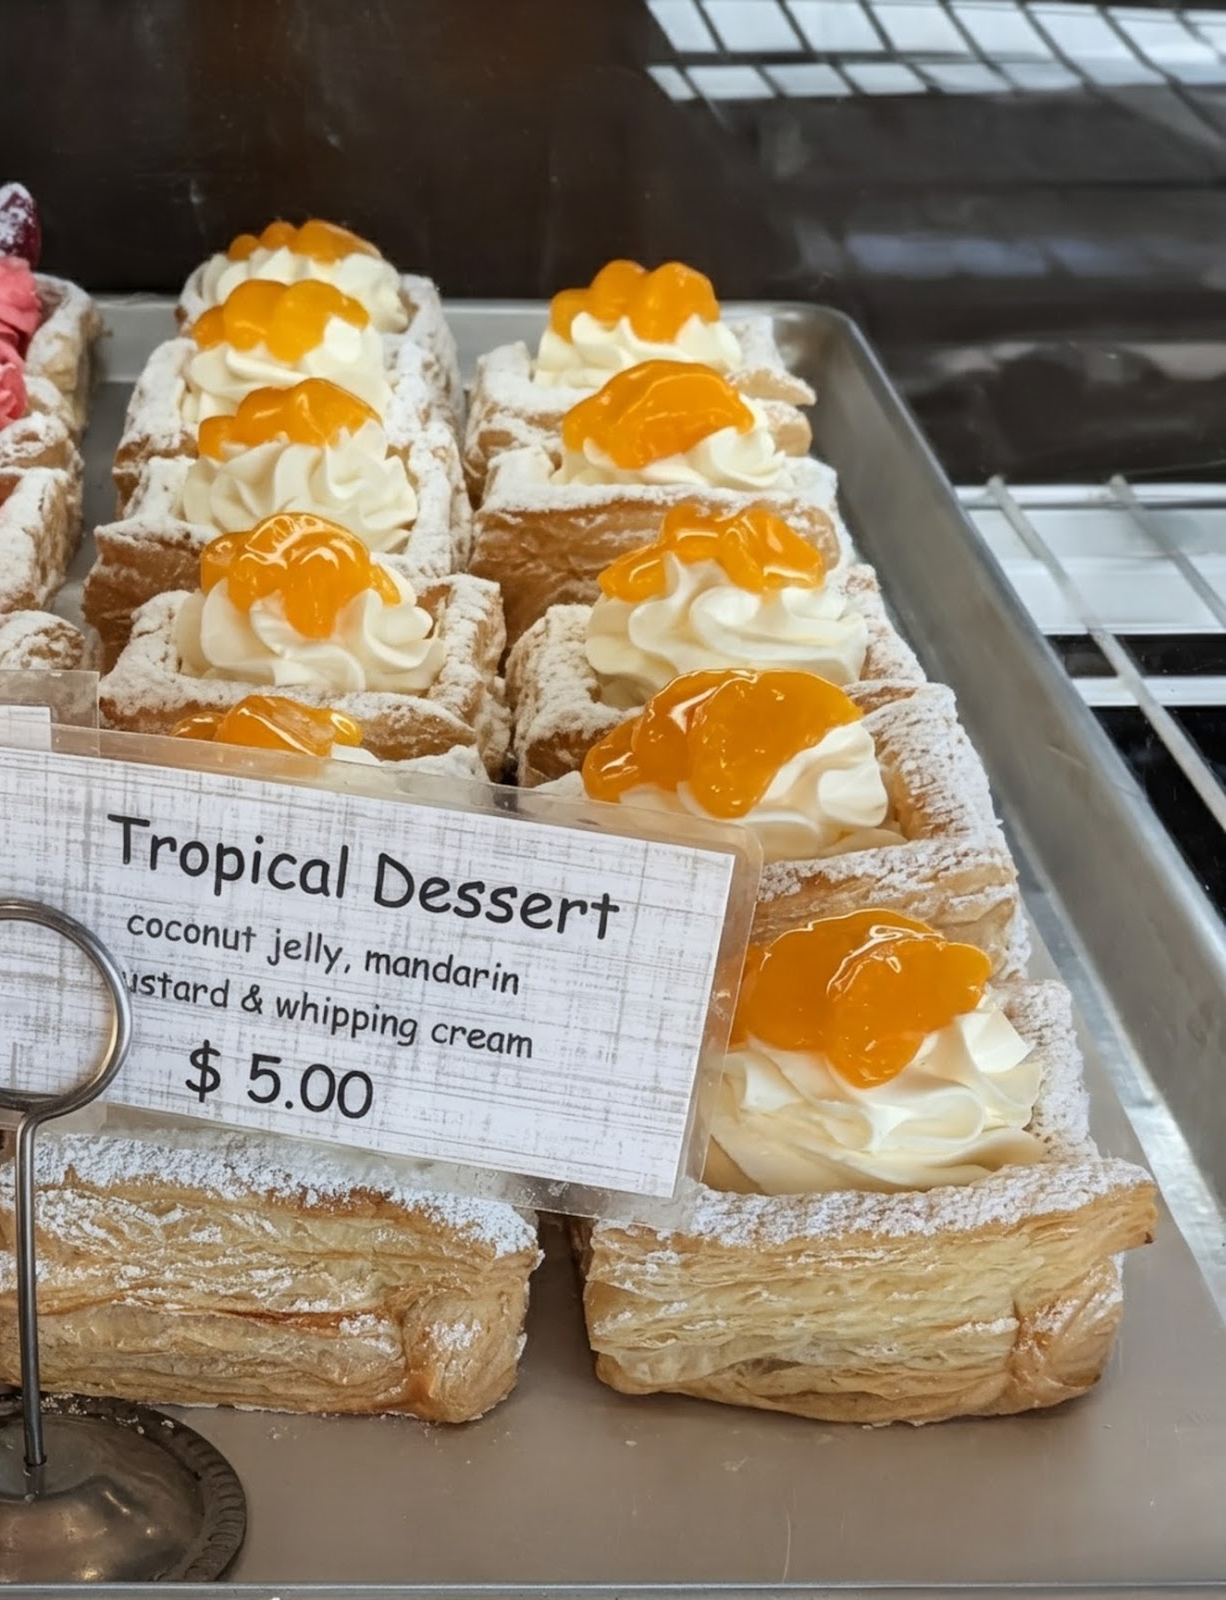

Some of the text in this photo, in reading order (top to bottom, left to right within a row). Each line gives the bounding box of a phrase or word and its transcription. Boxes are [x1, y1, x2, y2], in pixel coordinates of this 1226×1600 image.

[107, 813, 620, 940] Tropical Dessert
[127, 914, 519, 996] coconut jelly, mandarin
[121, 970, 532, 1059] ustard & whipping cream
[185, 1039, 374, 1119] $ 5.00
